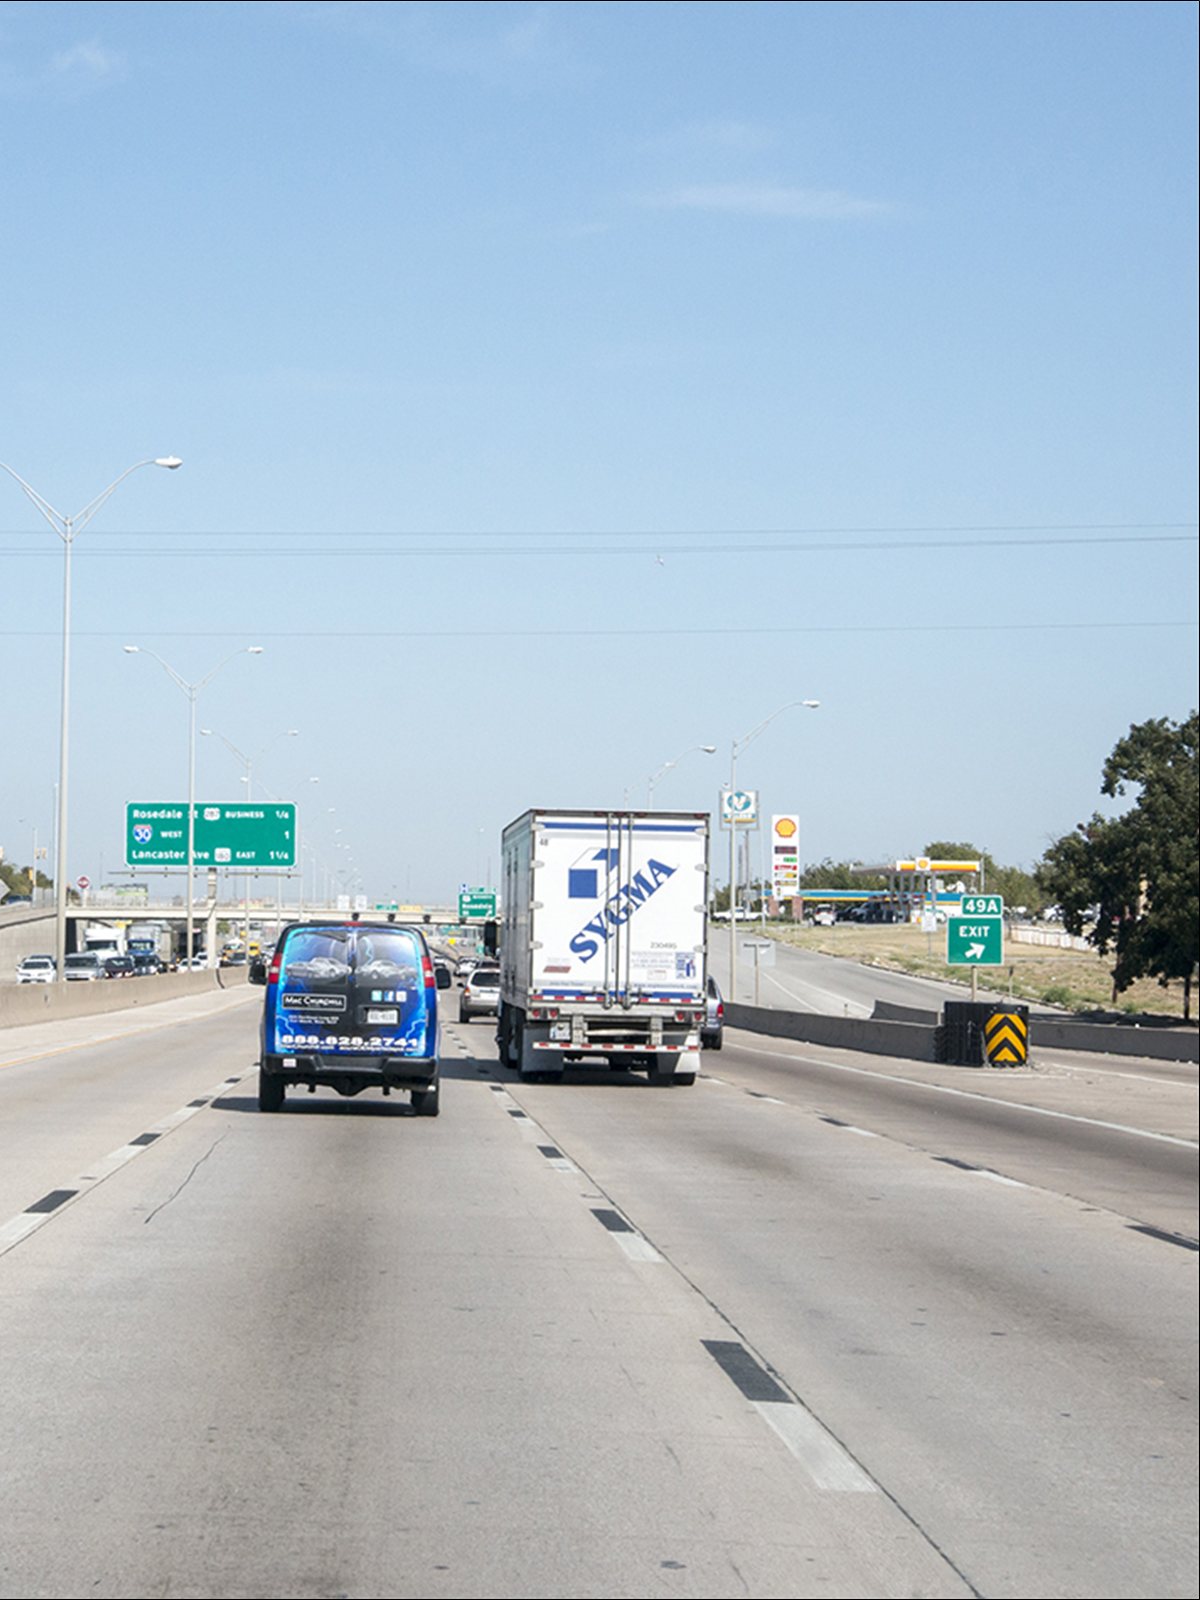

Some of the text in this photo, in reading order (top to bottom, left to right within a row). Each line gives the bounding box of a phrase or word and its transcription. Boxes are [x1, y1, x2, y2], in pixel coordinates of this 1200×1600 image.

[133, 809, 182, 819] Rosedale
[136, 828, 150, 839] 30
[284, 831, 289, 839] 1
[132, 850, 185, 860] Lancaster
[236, 851, 256, 859] EAST
[569, 858, 677, 964] SYGMA
[965, 899, 998, 913] 49A
[959, 926, 990, 937] EXIT
